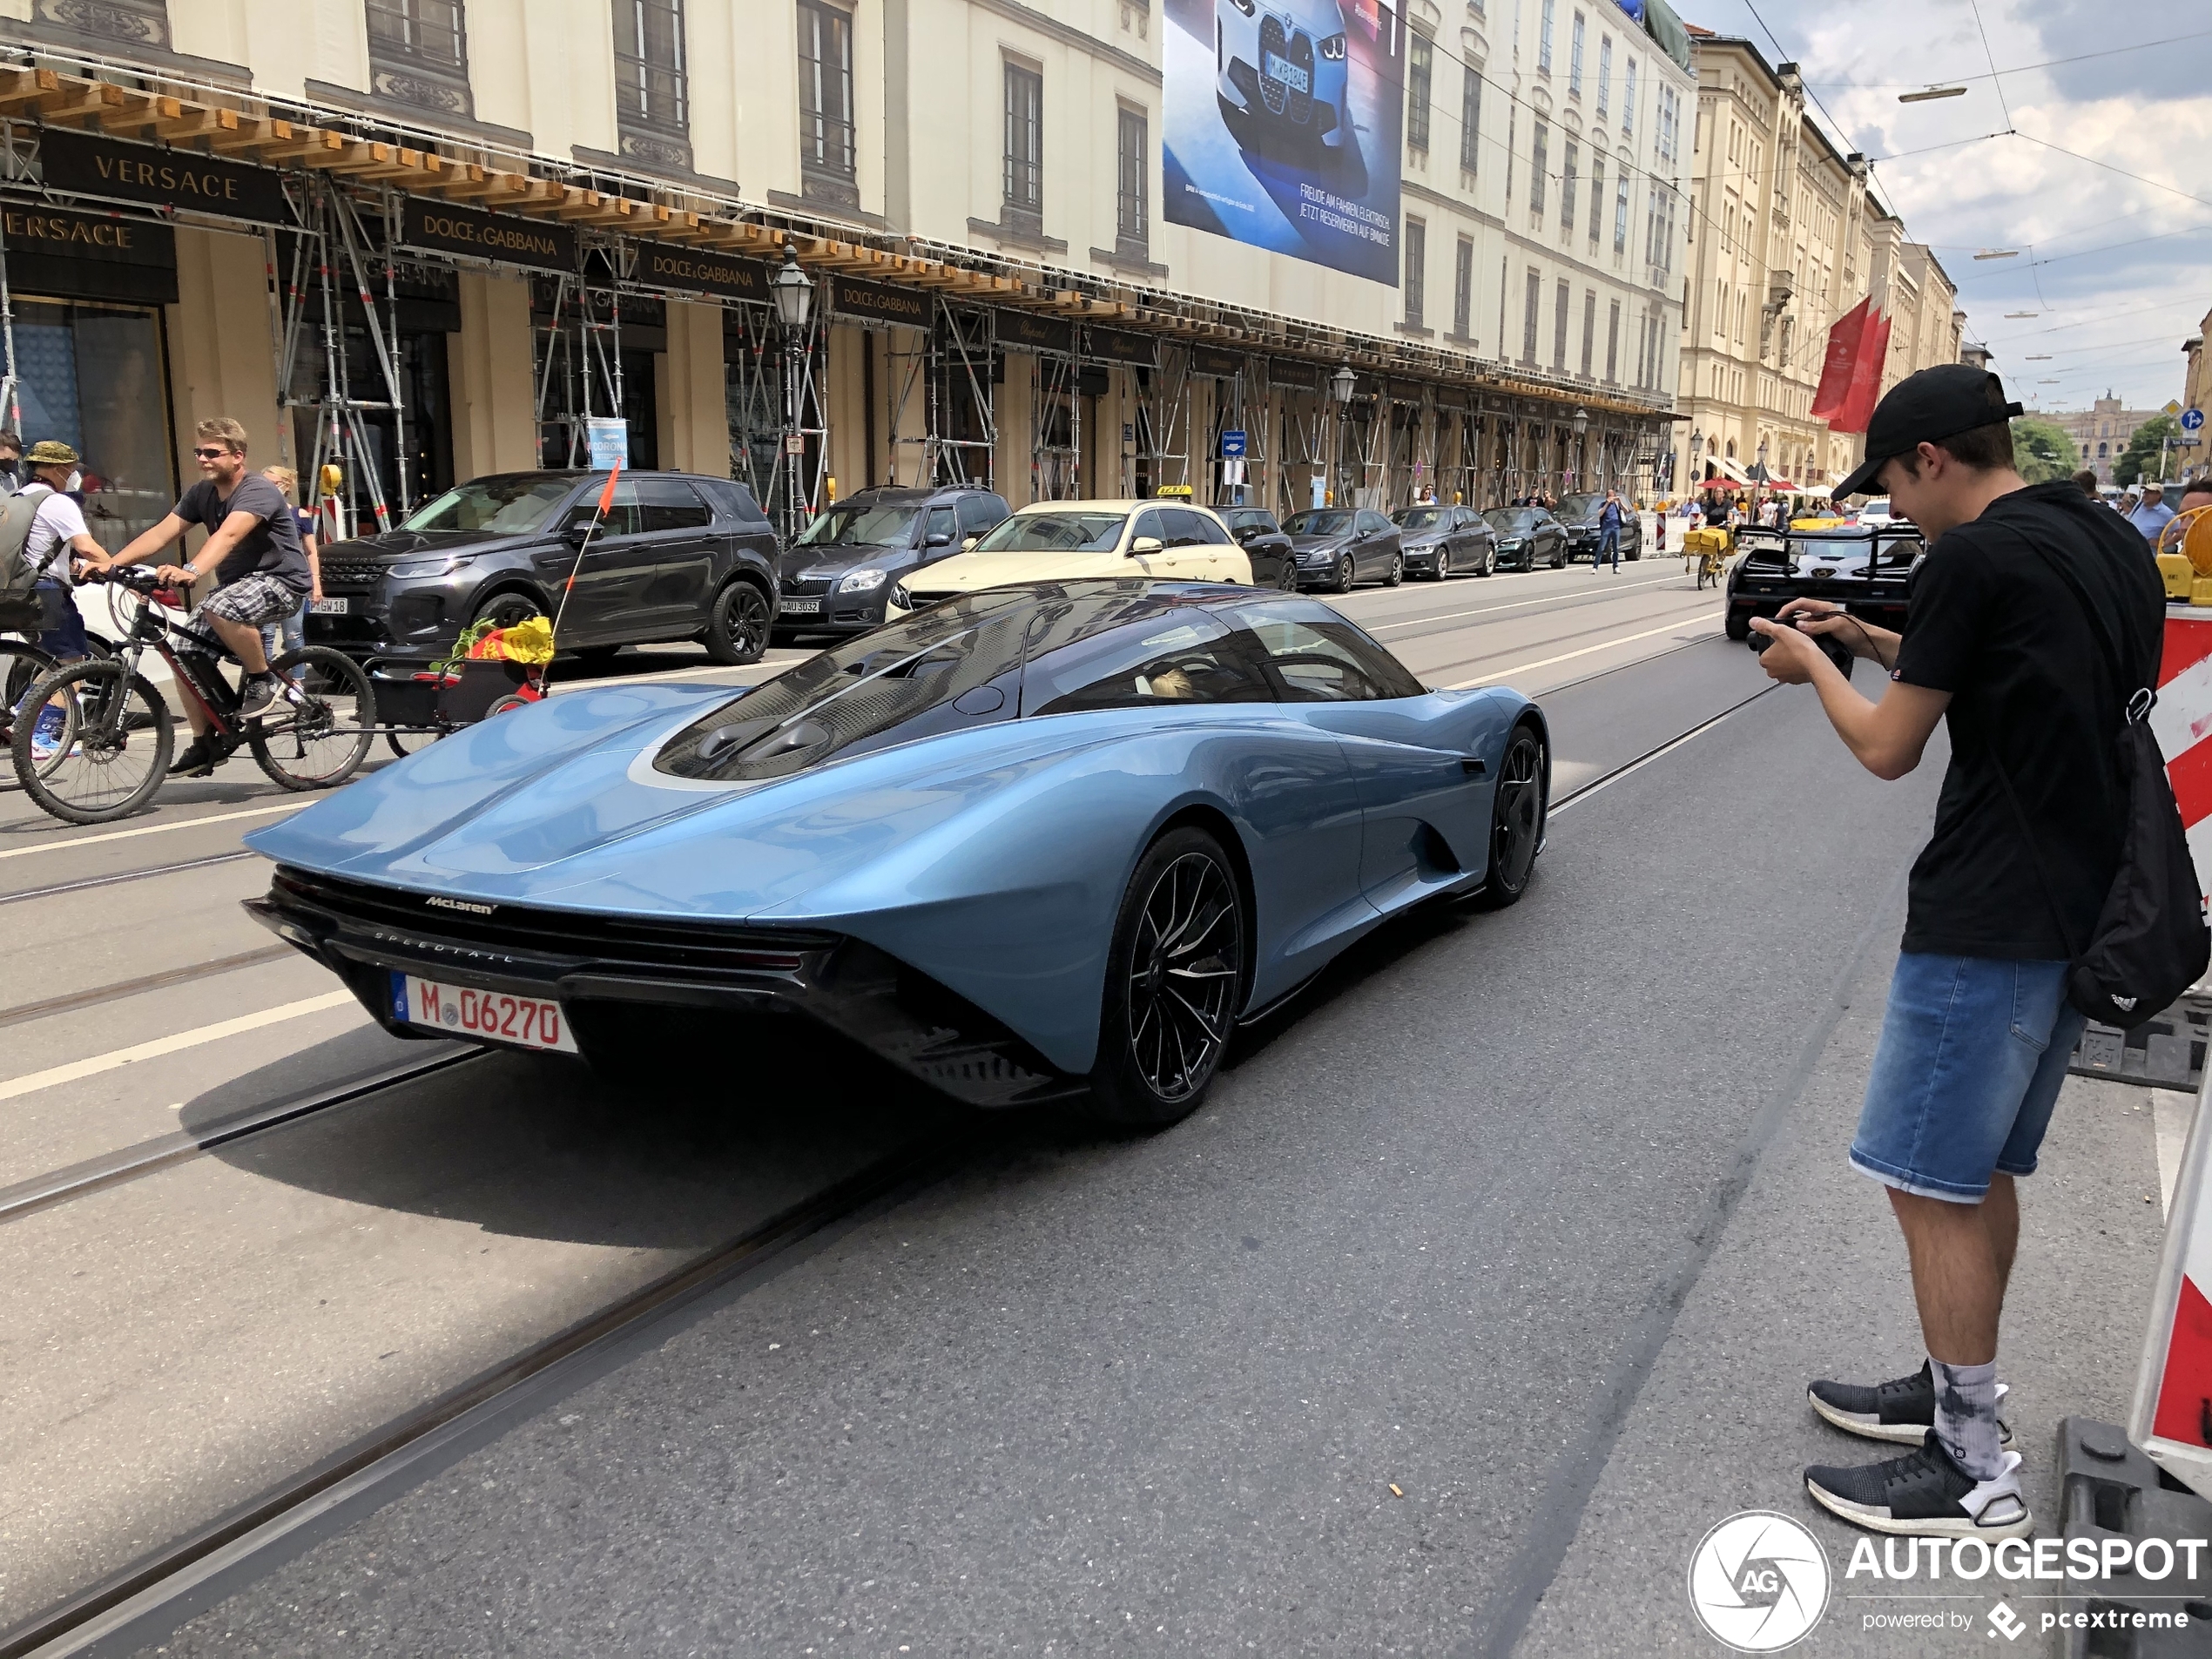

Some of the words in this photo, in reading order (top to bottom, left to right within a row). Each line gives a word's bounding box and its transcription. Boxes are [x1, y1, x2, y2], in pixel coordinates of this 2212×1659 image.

[95, 155, 239, 200] VERSACE
[1300, 182, 1325, 206] FREUDE
[1325, 192, 1336, 209] AM
[5, 212, 133, 248] ERSACE
[424, 214, 474, 241] DOLCE
[482, 226, 557, 256] GABBANA
[1299, 202, 1320, 221] JETZT
[1359, 224, 1370, 239] AUF
[653, 255, 691, 278] DOLCE
[697, 264, 753, 287] GABBANA
[844, 288, 873, 307] DOLCE
[877, 294, 921, 315] GABBANA
[593, 442, 627, 452] CORONA
[320, 600, 333, 612] GW
[334, 601, 345, 612] 18
[786, 602, 797, 611] AU
[798, 602, 818, 611] 3032
[425, 895, 498, 915] McLaren
[374, 932, 514, 963] SPEEDTAIL
[420, 981, 441, 1023] M
[460, 989, 560, 1045] 06270
